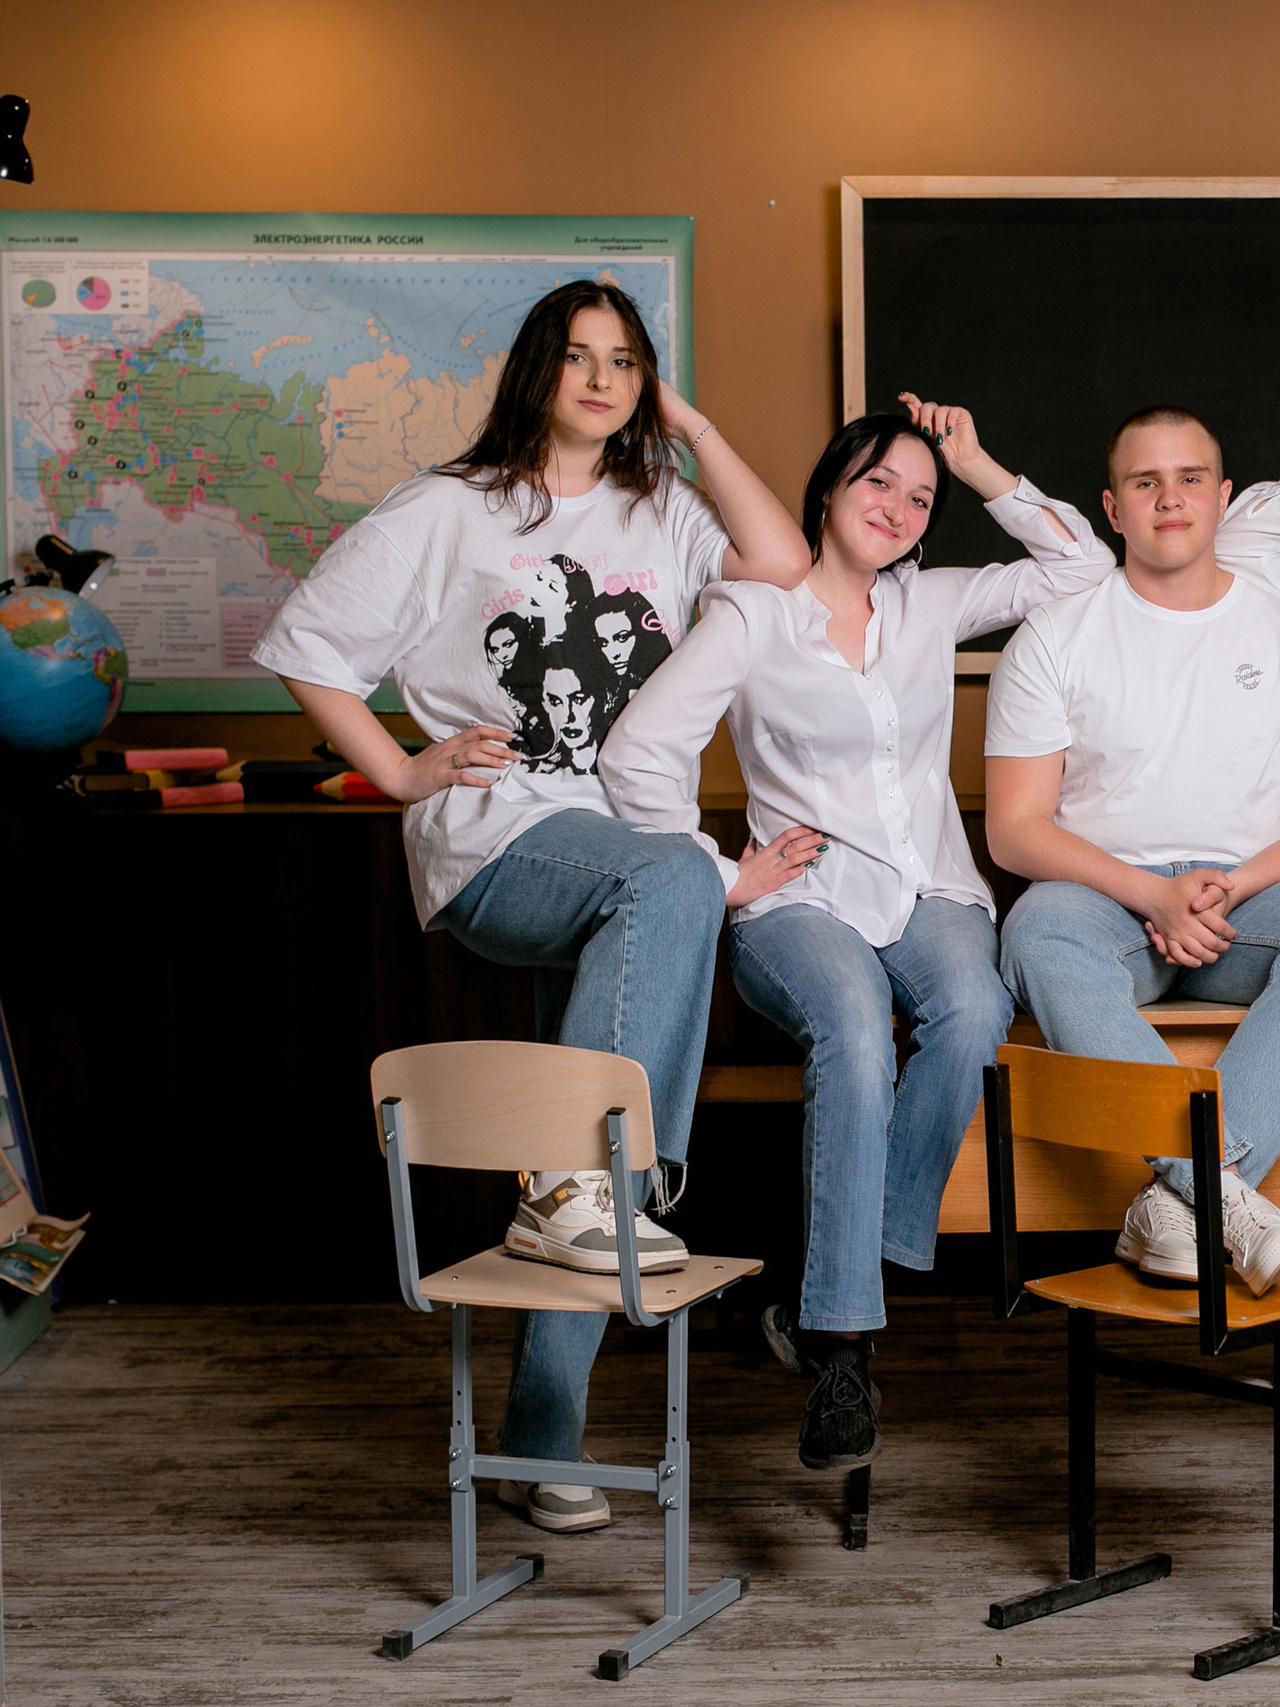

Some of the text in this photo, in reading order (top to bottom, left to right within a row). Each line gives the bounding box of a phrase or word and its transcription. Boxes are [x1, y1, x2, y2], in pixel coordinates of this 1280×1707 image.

[253, 234, 423, 245] ЭЛЕКТРОЭНЕРГЕТИКА РОССИИ
[603, 568, 659, 597] Girl
[480, 588, 526, 620] Girls
